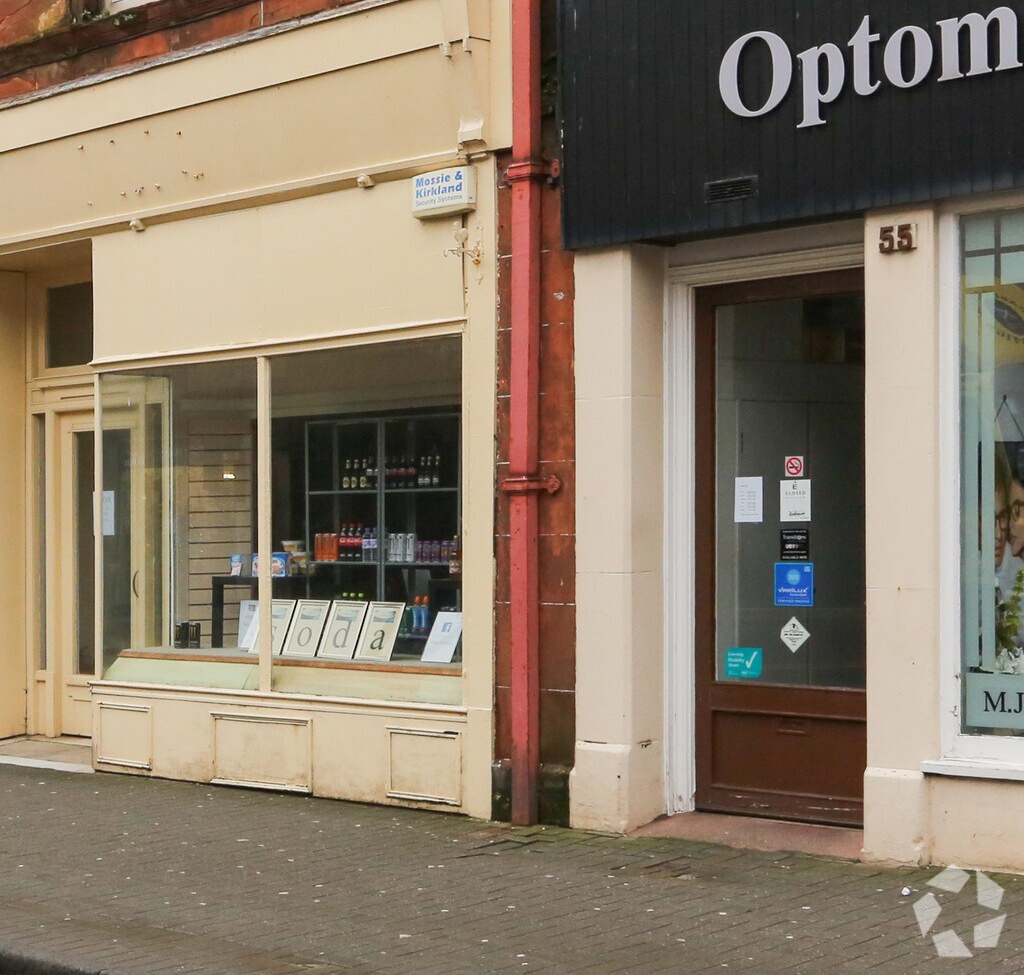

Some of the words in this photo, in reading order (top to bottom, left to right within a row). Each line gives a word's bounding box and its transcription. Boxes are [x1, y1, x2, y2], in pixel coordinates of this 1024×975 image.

[719, 6, 1024, 129] Optom
[416, 173, 451, 188] Mossie
[455, 170, 463, 181] &
[416, 182, 463, 199] Kirkland
[438, 194, 463, 203] Systems
[879, 223, 914, 254] 55
